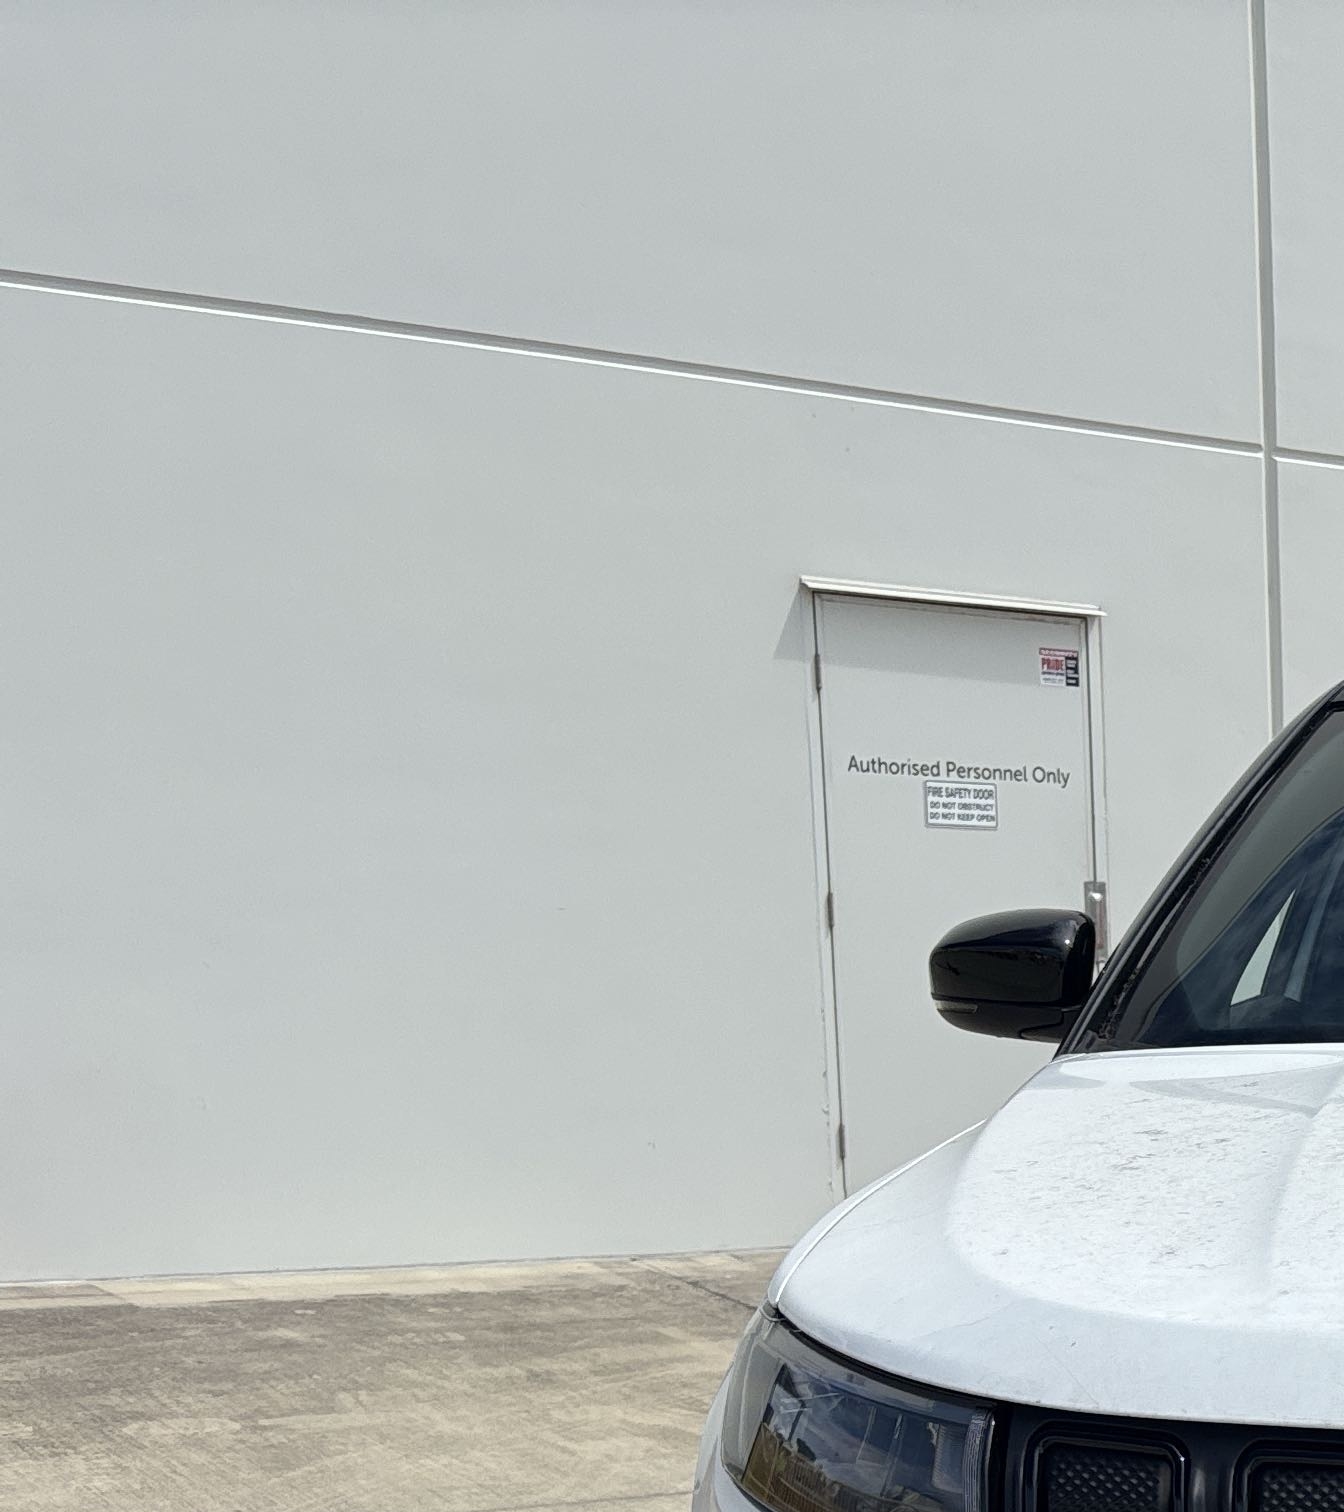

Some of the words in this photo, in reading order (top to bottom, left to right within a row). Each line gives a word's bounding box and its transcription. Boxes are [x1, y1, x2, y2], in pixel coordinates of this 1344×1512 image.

[847, 755, 941, 778] Authorised
[946, 761, 1028, 783] Personnel
[1032, 766, 1071, 789] Only
[927, 786, 943, 798] FIRE
[944, 787, 971, 799] SAFETY
[973, 788, 994, 800] DOOR
